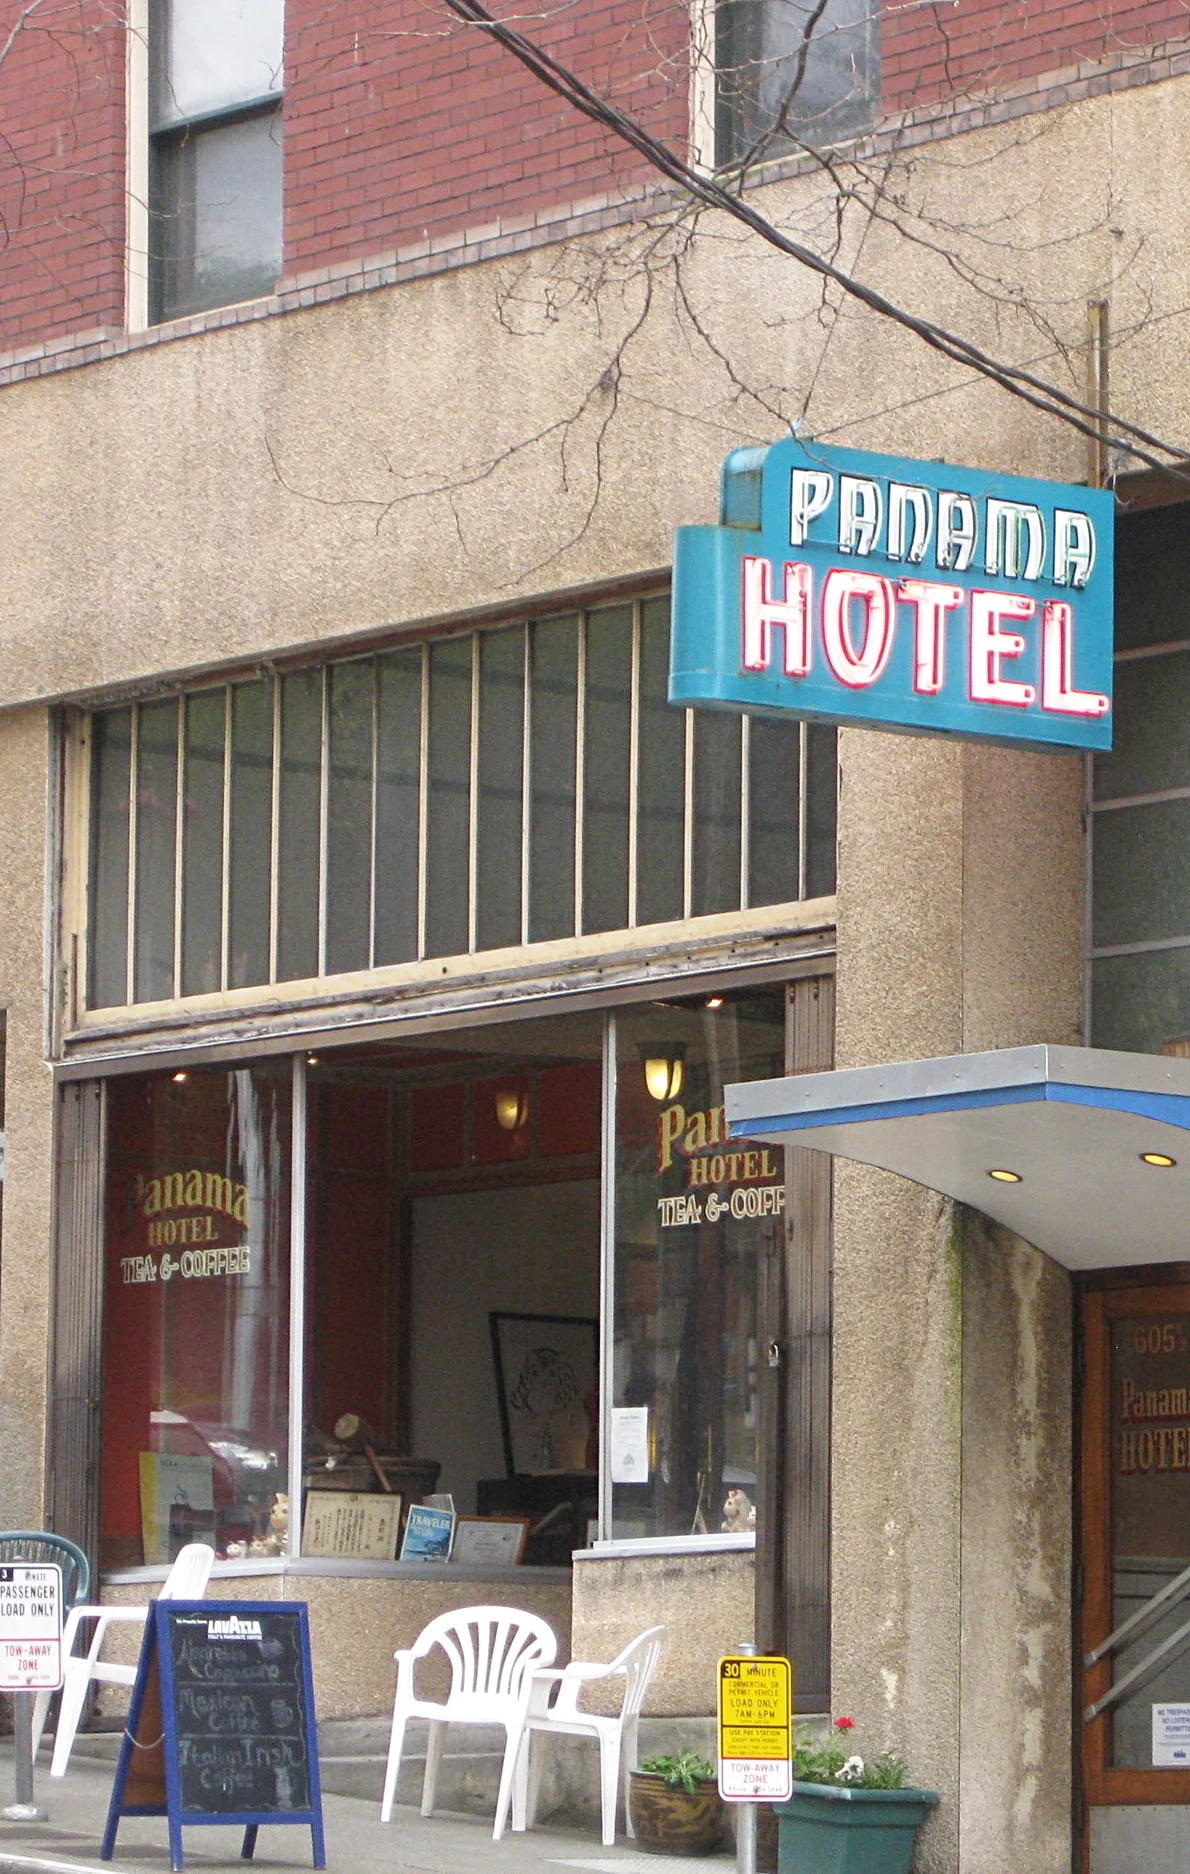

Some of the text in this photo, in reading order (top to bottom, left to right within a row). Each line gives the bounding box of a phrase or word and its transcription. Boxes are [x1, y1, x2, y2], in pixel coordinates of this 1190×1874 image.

[789, 467, 1097, 591] PANAMA
[741, 555, 1110, 717] HOTEL
[658, 1104, 731, 1173] Pan
[689, 1150, 777, 1186] HOTEL
[122, 1170, 250, 1237] Panama
[657, 1185, 785, 1227] TEA & COFF
[148, 1216, 218, 1247] HOTEL
[121, 1246, 251, 1283] TEA & COFFEE
[1134, 1323, 1177, 1353] 605
[2, 1569, 8, 1579] 3
[0, 1586, 55, 1598] PASSENGER
[1, 1604, 54, 1616] LOAD ONLY
[208, 1616, 262, 1634] LAVAZZA
[5, 1646, 51, 1656] TOW-AWAY
[18, 1660, 39, 1671] ZONE
[724, 1663, 777, 1677] 30 MINUTE
[730, 1698, 778, 1708] LOAD ONLY
[730, 1763, 780, 1773] TOW-AWAY
[743, 1774, 768, 1784] ZONE
